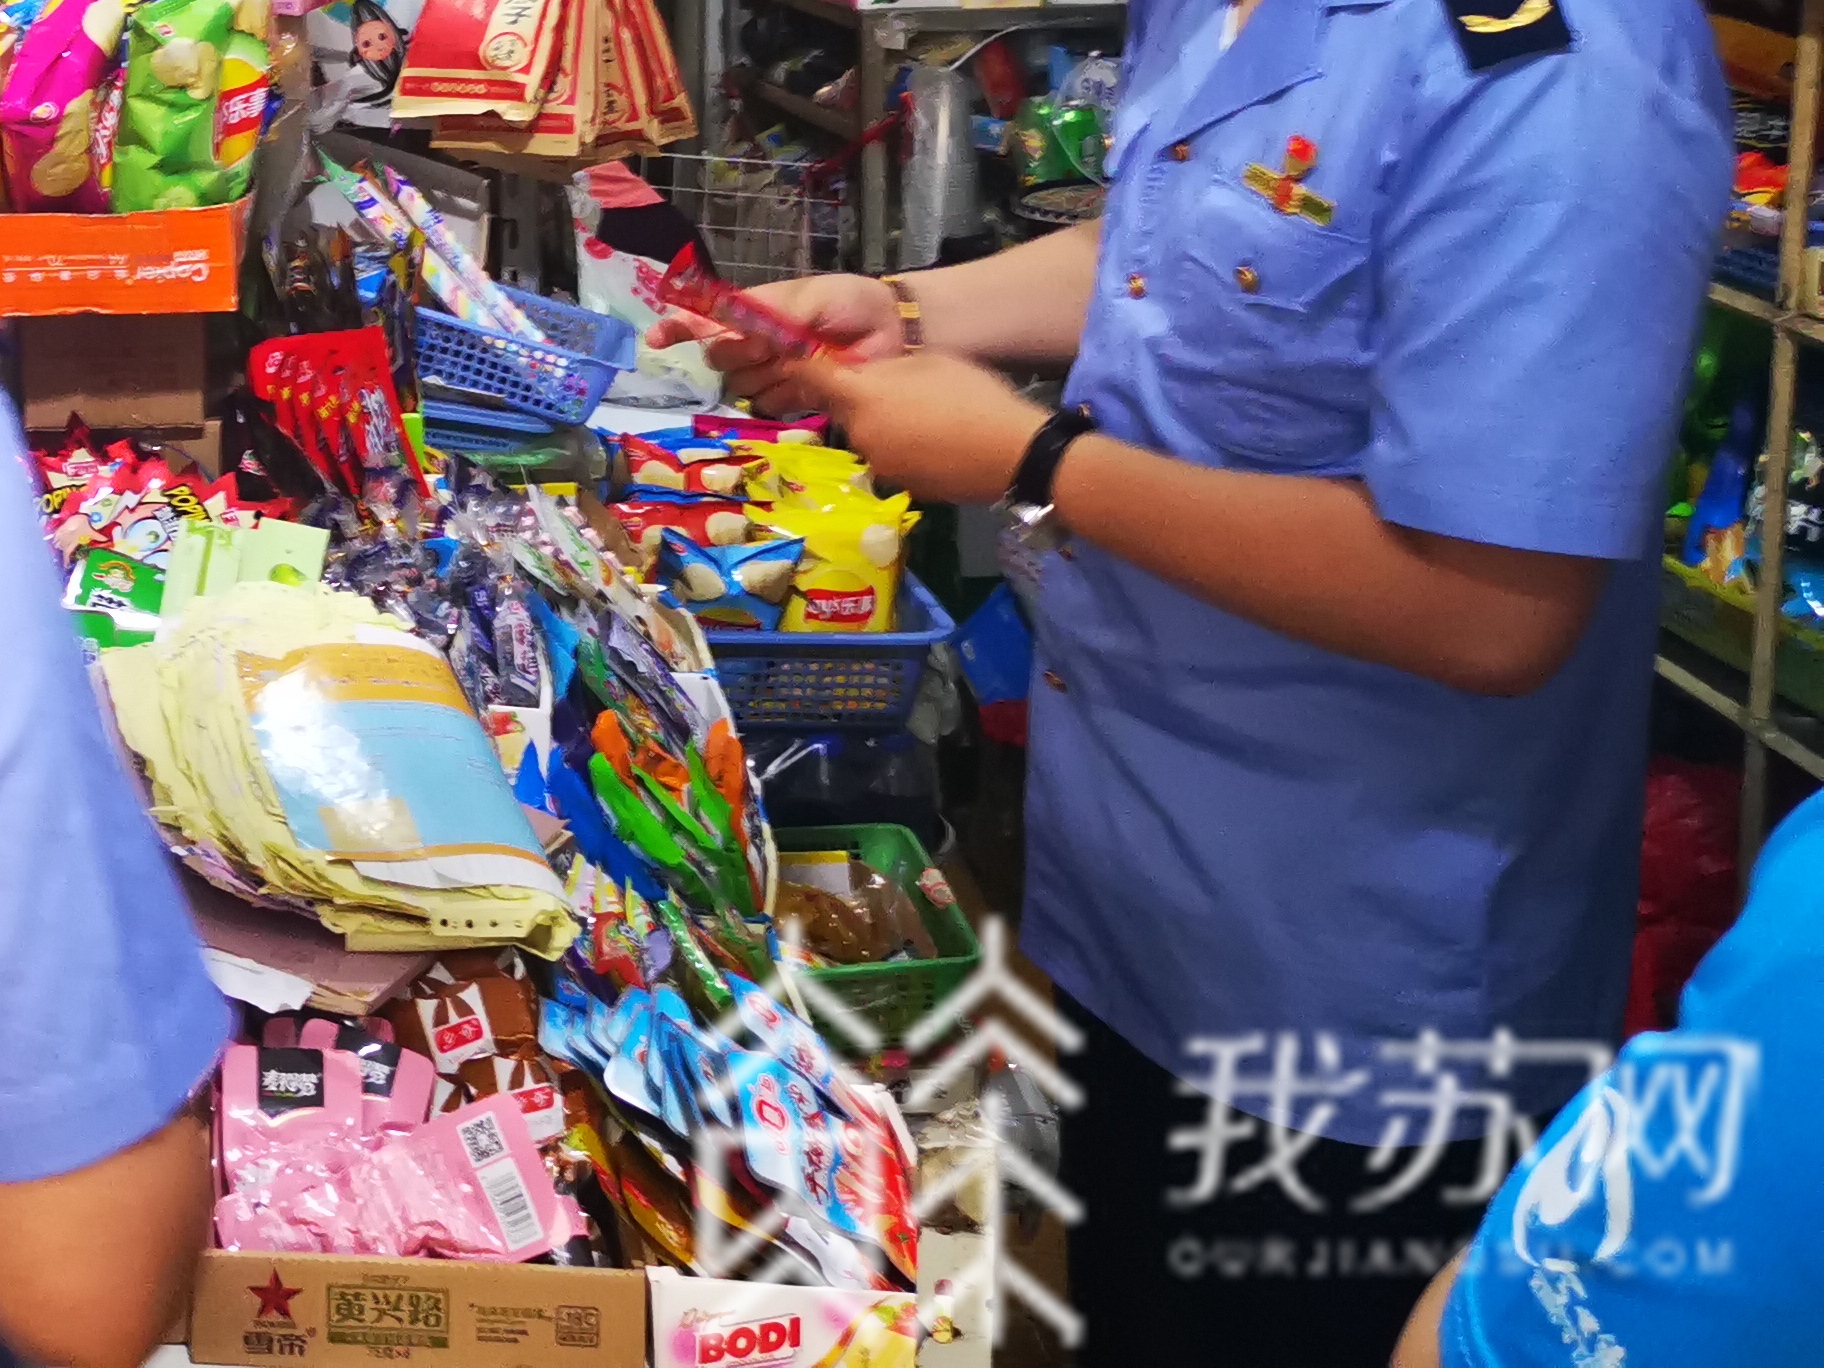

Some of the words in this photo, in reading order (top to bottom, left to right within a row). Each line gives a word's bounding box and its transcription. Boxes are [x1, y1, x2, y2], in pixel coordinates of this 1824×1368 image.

[330, 1290, 443, 1328] 黄兴路
[698, 1316, 802, 1365] BODI
